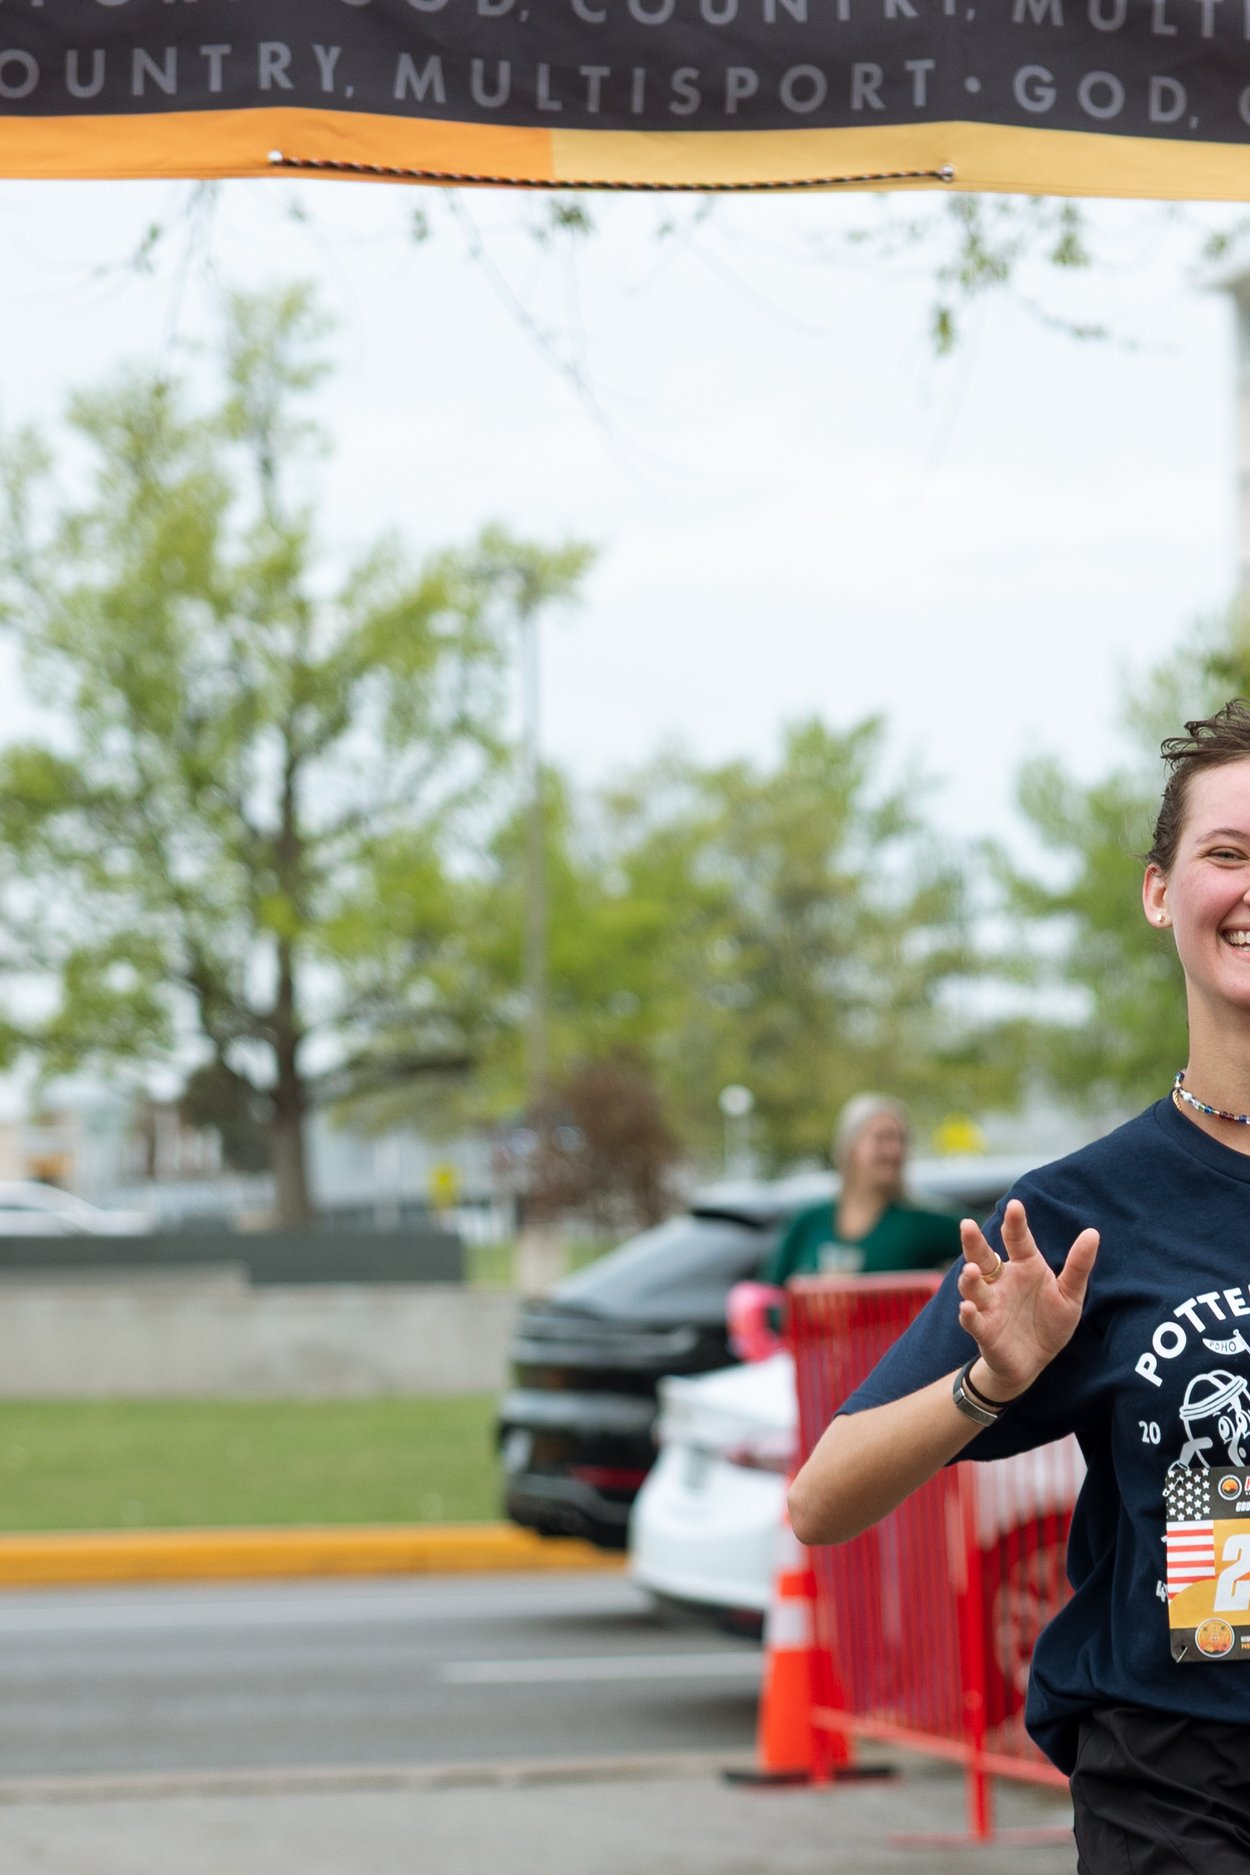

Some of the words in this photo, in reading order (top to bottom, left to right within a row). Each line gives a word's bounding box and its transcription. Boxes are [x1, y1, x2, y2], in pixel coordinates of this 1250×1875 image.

[0, 41, 355, 99] OUNTRY,
[392, 52, 936, 115] MULTISPORT
[1010, 64, 1200, 130] GOD,
[1138, 1420, 1161, 1445] 20
